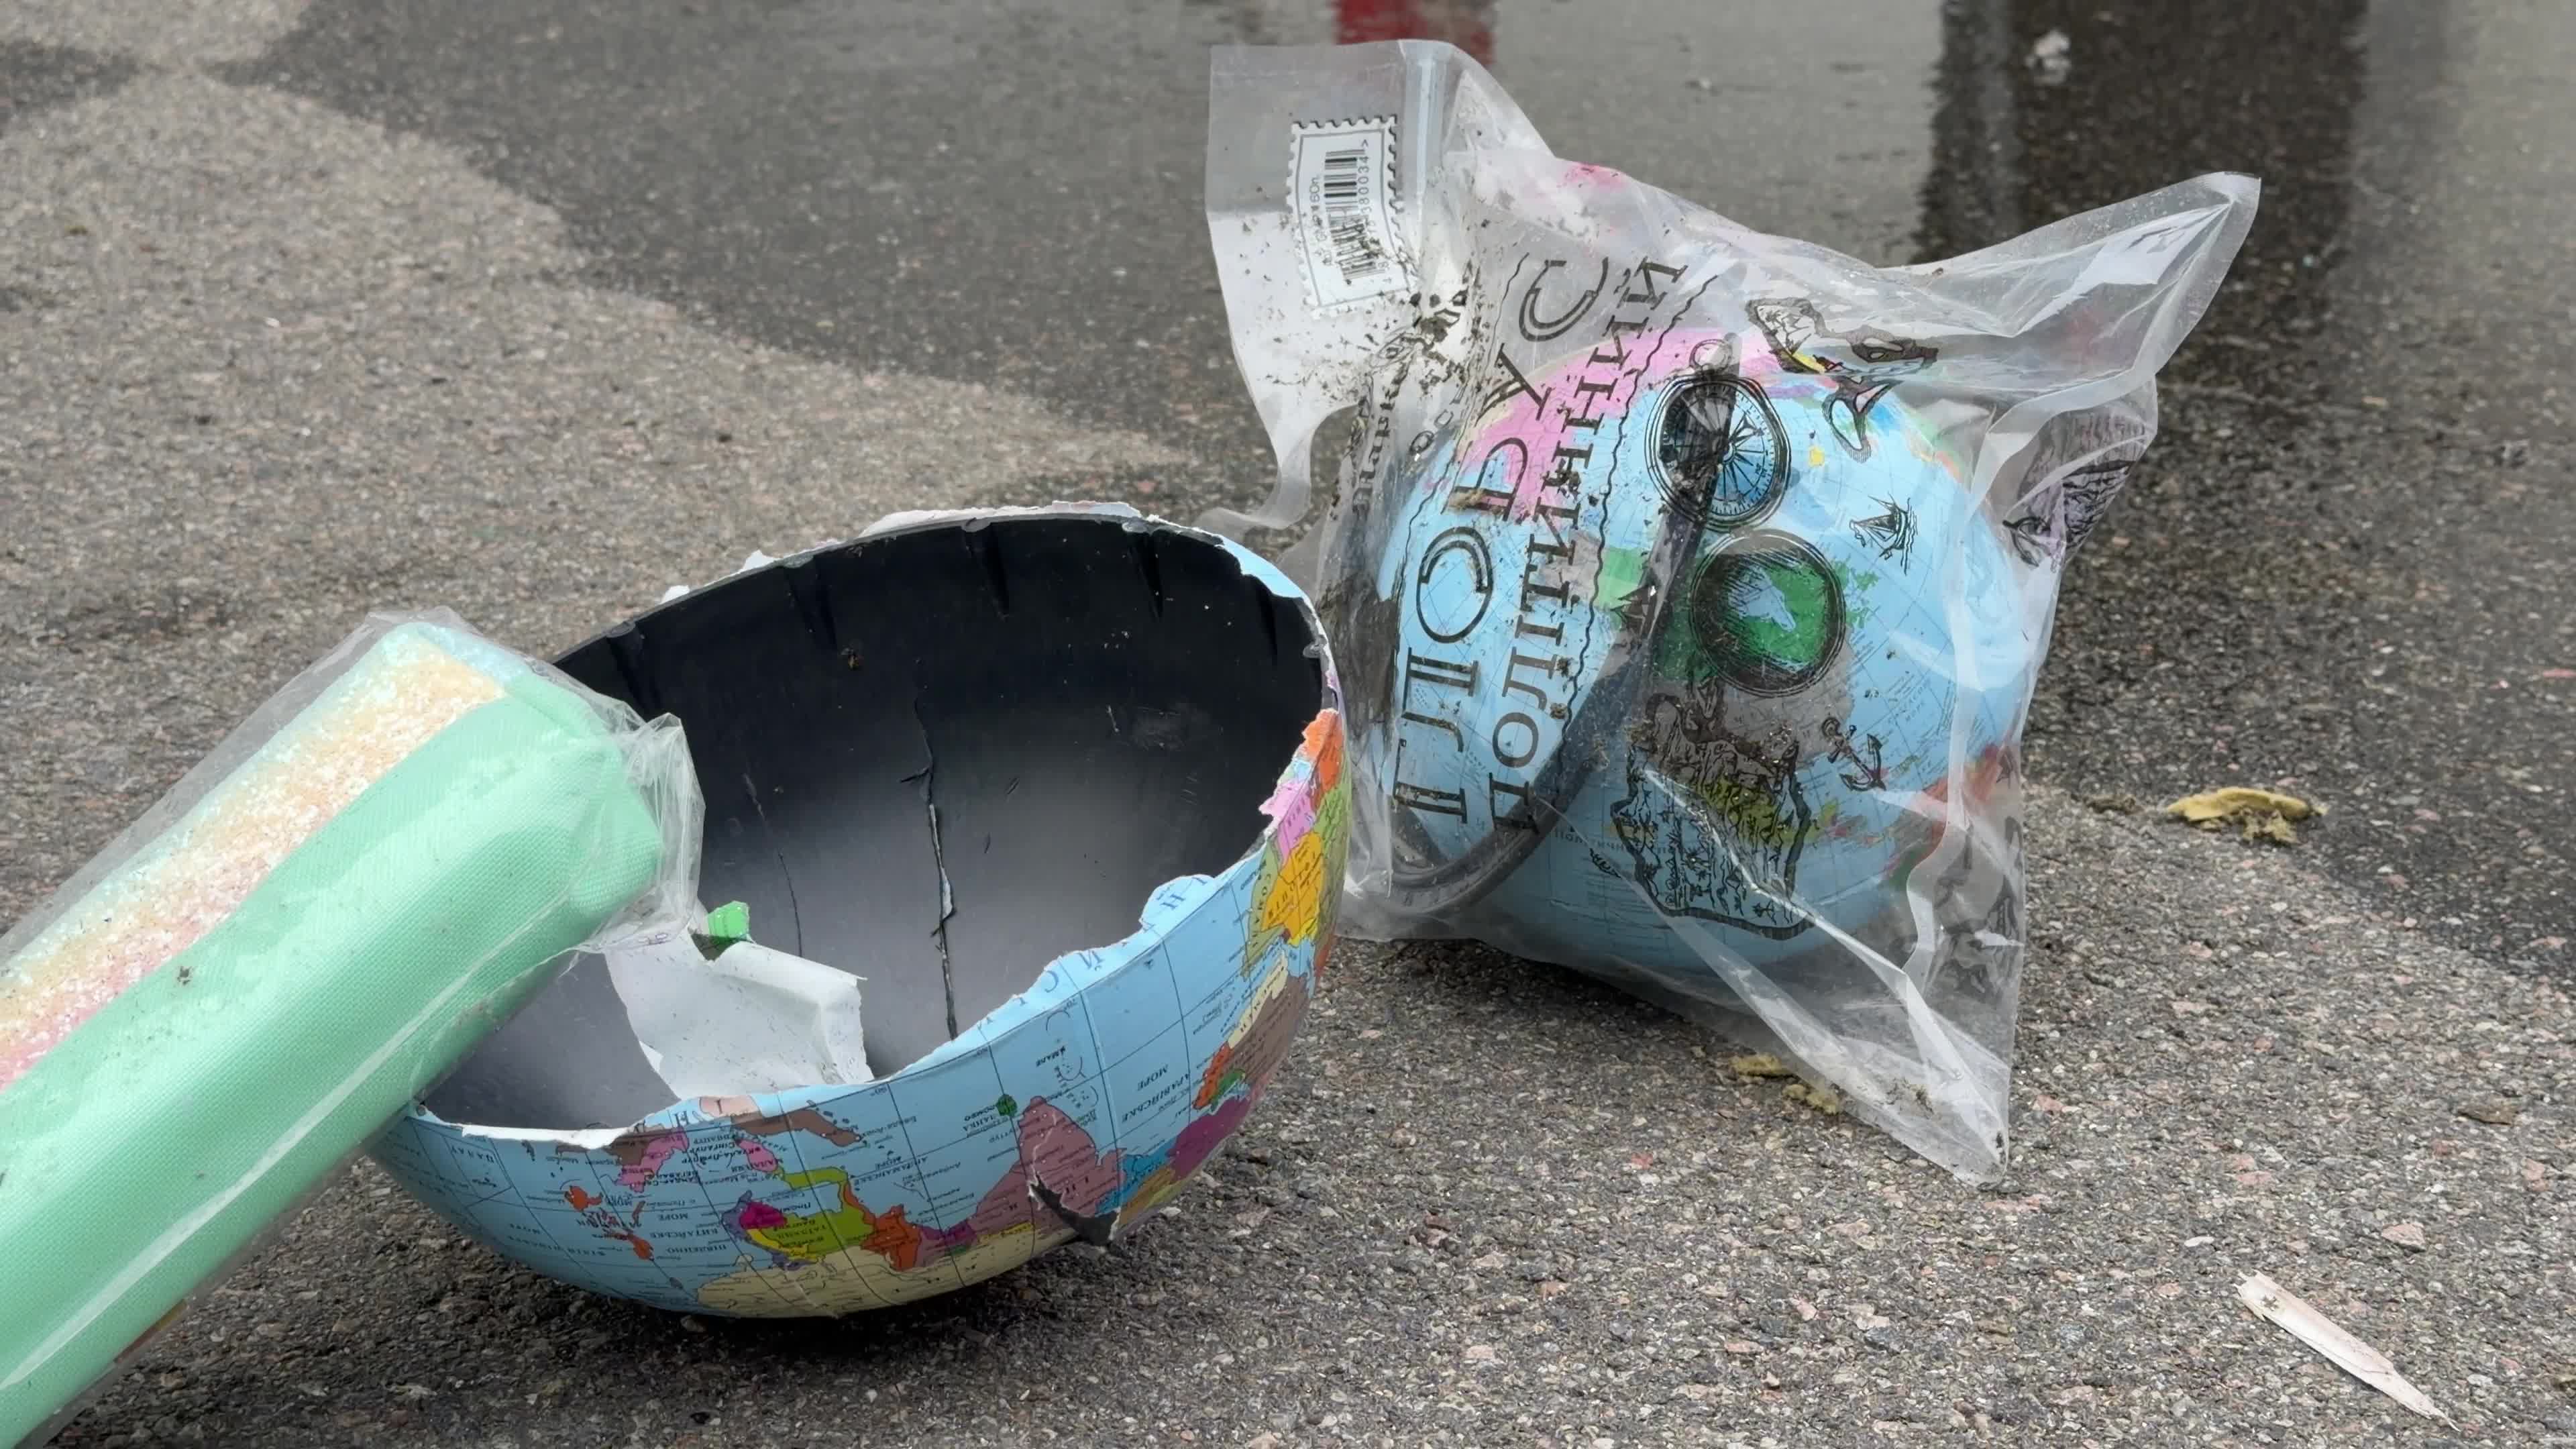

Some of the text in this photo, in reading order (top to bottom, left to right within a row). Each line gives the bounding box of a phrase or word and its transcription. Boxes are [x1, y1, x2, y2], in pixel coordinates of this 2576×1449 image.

[1357, 156, 1373, 215] 380034
[1393, 256, 1609, 824] ГЛОБУС
[1488, 255, 1688, 835] ПОЛІТИЧНИЙ
[1137, 1063, 1169, 1092] МОРЕ
[658, 1212, 689, 1222] МОРЕ
